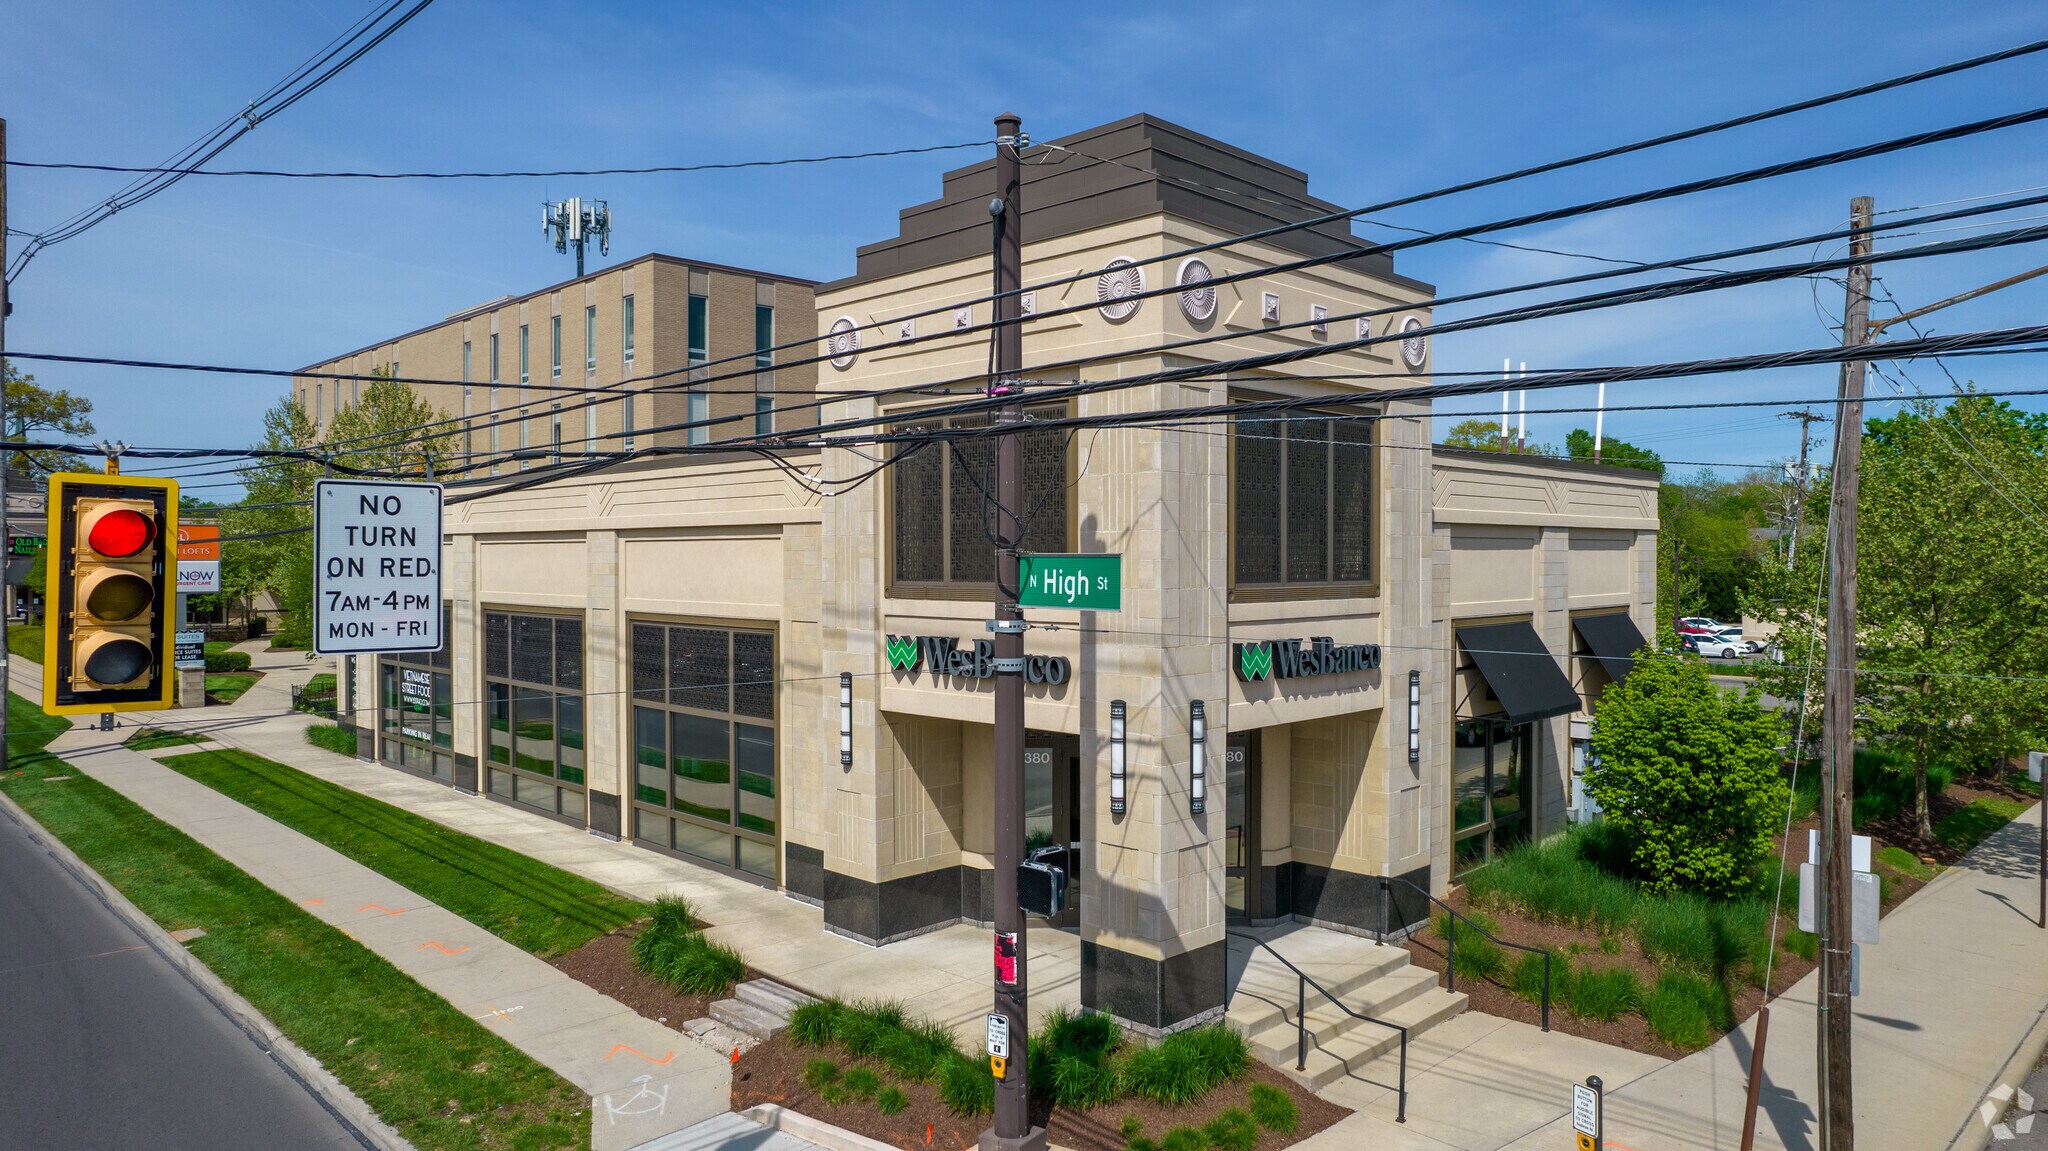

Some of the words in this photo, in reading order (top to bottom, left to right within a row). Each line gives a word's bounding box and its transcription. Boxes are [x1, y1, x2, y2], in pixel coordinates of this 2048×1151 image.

[360, 494, 402, 516] NO
[15, 537, 32, 546] OLD
[344, 526, 416, 547] TURN
[182, 547, 211, 555] LOFTS
[326, 557, 364, 578] ON
[380, 557, 432, 578] RED
[1029, 574, 1038, 588] N
[1043, 568, 1089, 604] High
[1096, 576, 1109, 590] St
[329, 622, 375, 639] MON
[396, 620, 428, 637] FRI
[922, 636, 1067, 686] WesBco
[1276, 636, 1382, 680] WesBanco
[402, 682, 417, 695] STREET
[1024, 752, 1050, 764] 380
